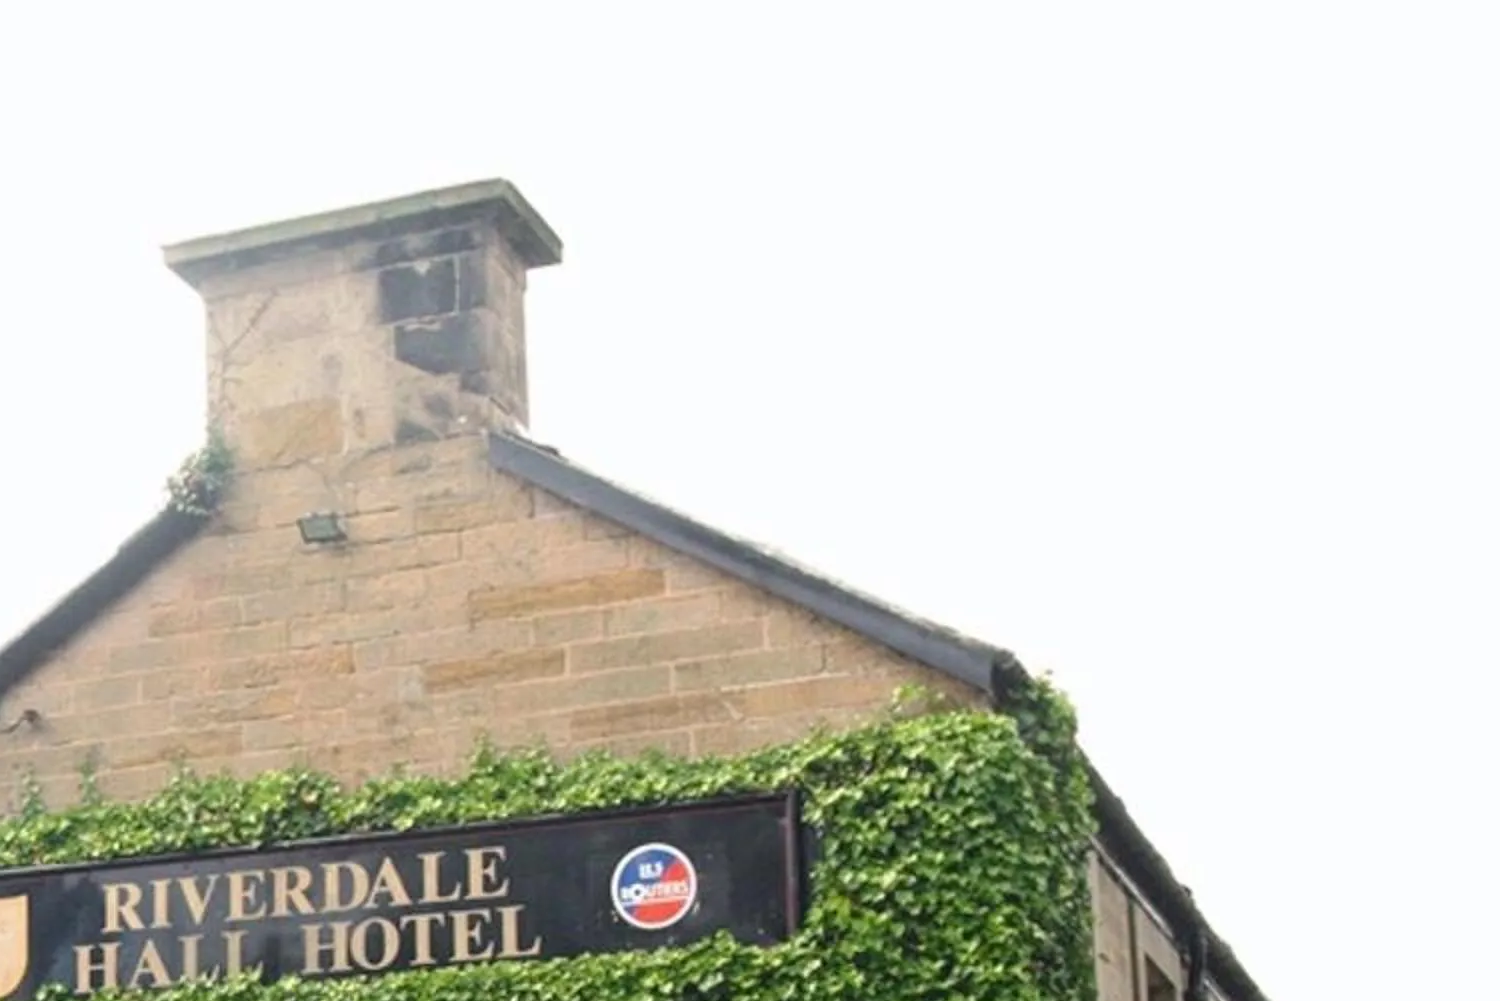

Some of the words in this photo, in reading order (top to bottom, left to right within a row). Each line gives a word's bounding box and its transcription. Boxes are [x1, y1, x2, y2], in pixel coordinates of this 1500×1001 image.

[101, 846, 511, 934] RIVERDALE
[73, 929, 265, 995] HALL
[299, 904, 543, 975] HOTEL
